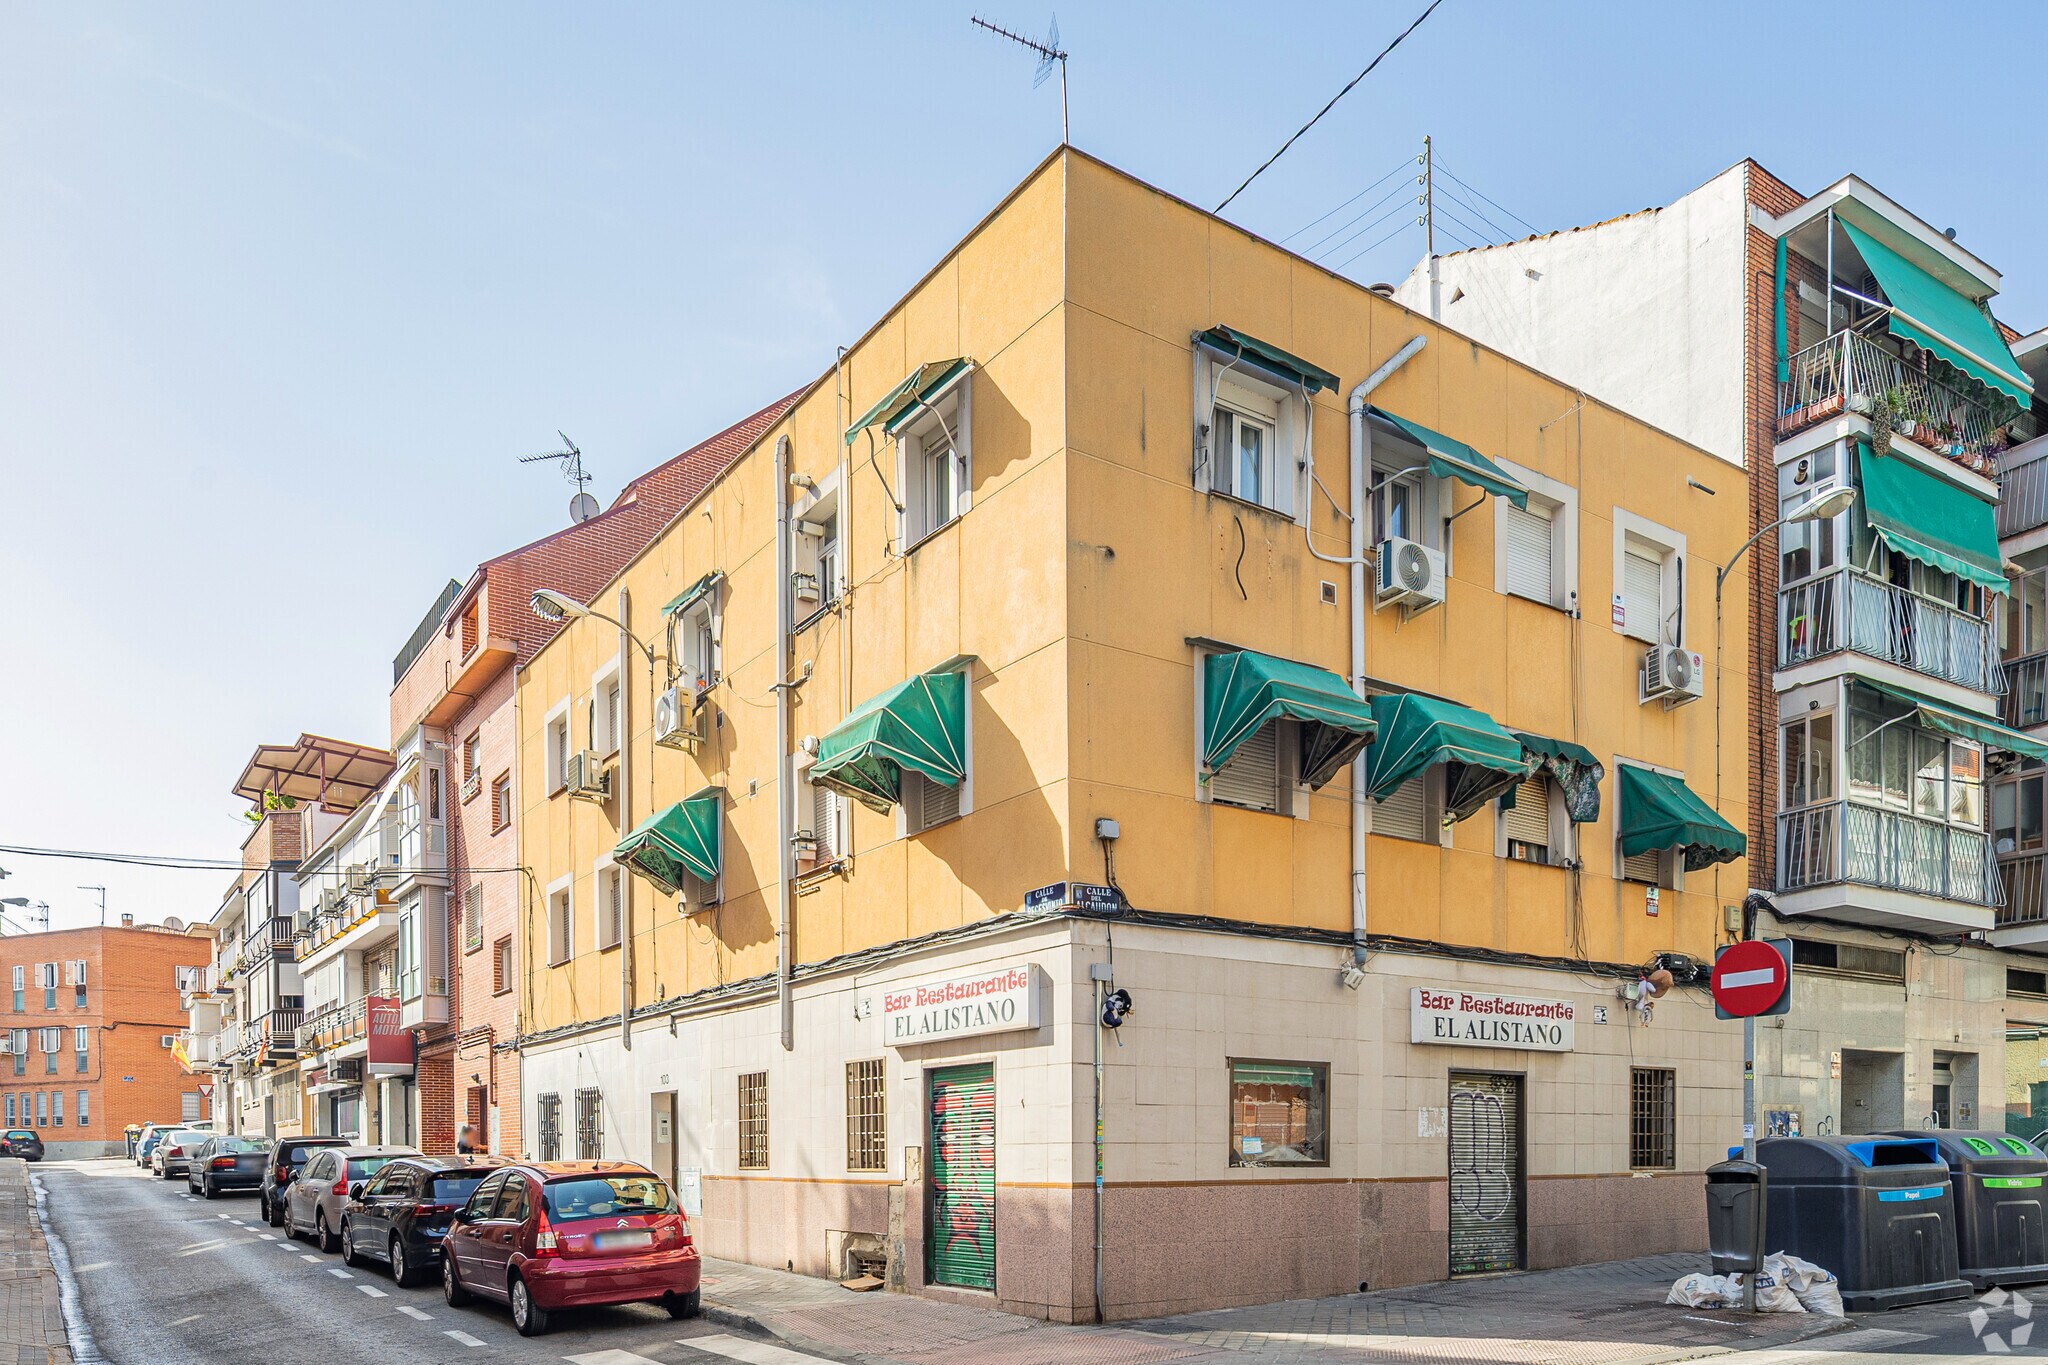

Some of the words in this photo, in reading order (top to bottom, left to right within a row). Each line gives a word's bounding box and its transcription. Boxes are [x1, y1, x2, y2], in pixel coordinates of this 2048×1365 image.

[1035, 887, 1054, 898] CALLE
[1086, 887, 1112, 896] CALLE
[885, 994, 911, 1012] Bar
[915, 970, 1027, 1007] Restaurante
[1420, 990, 1454, 1009] Bar
[1459, 993, 1574, 1020] Restaurante
[895, 1014, 916, 1038] EL
[919, 998, 1015, 1034] ALISTANO
[373, 1025, 406, 1036] MOTOR
[1434, 1016, 1460, 1038] EL
[1464, 1019, 1562, 1045] ALISTANO
[661, 1074, 669, 1084] 103
[2007, 1179, 2023, 1187] Vidrio
[1905, 1191, 1920, 1199] Papel
